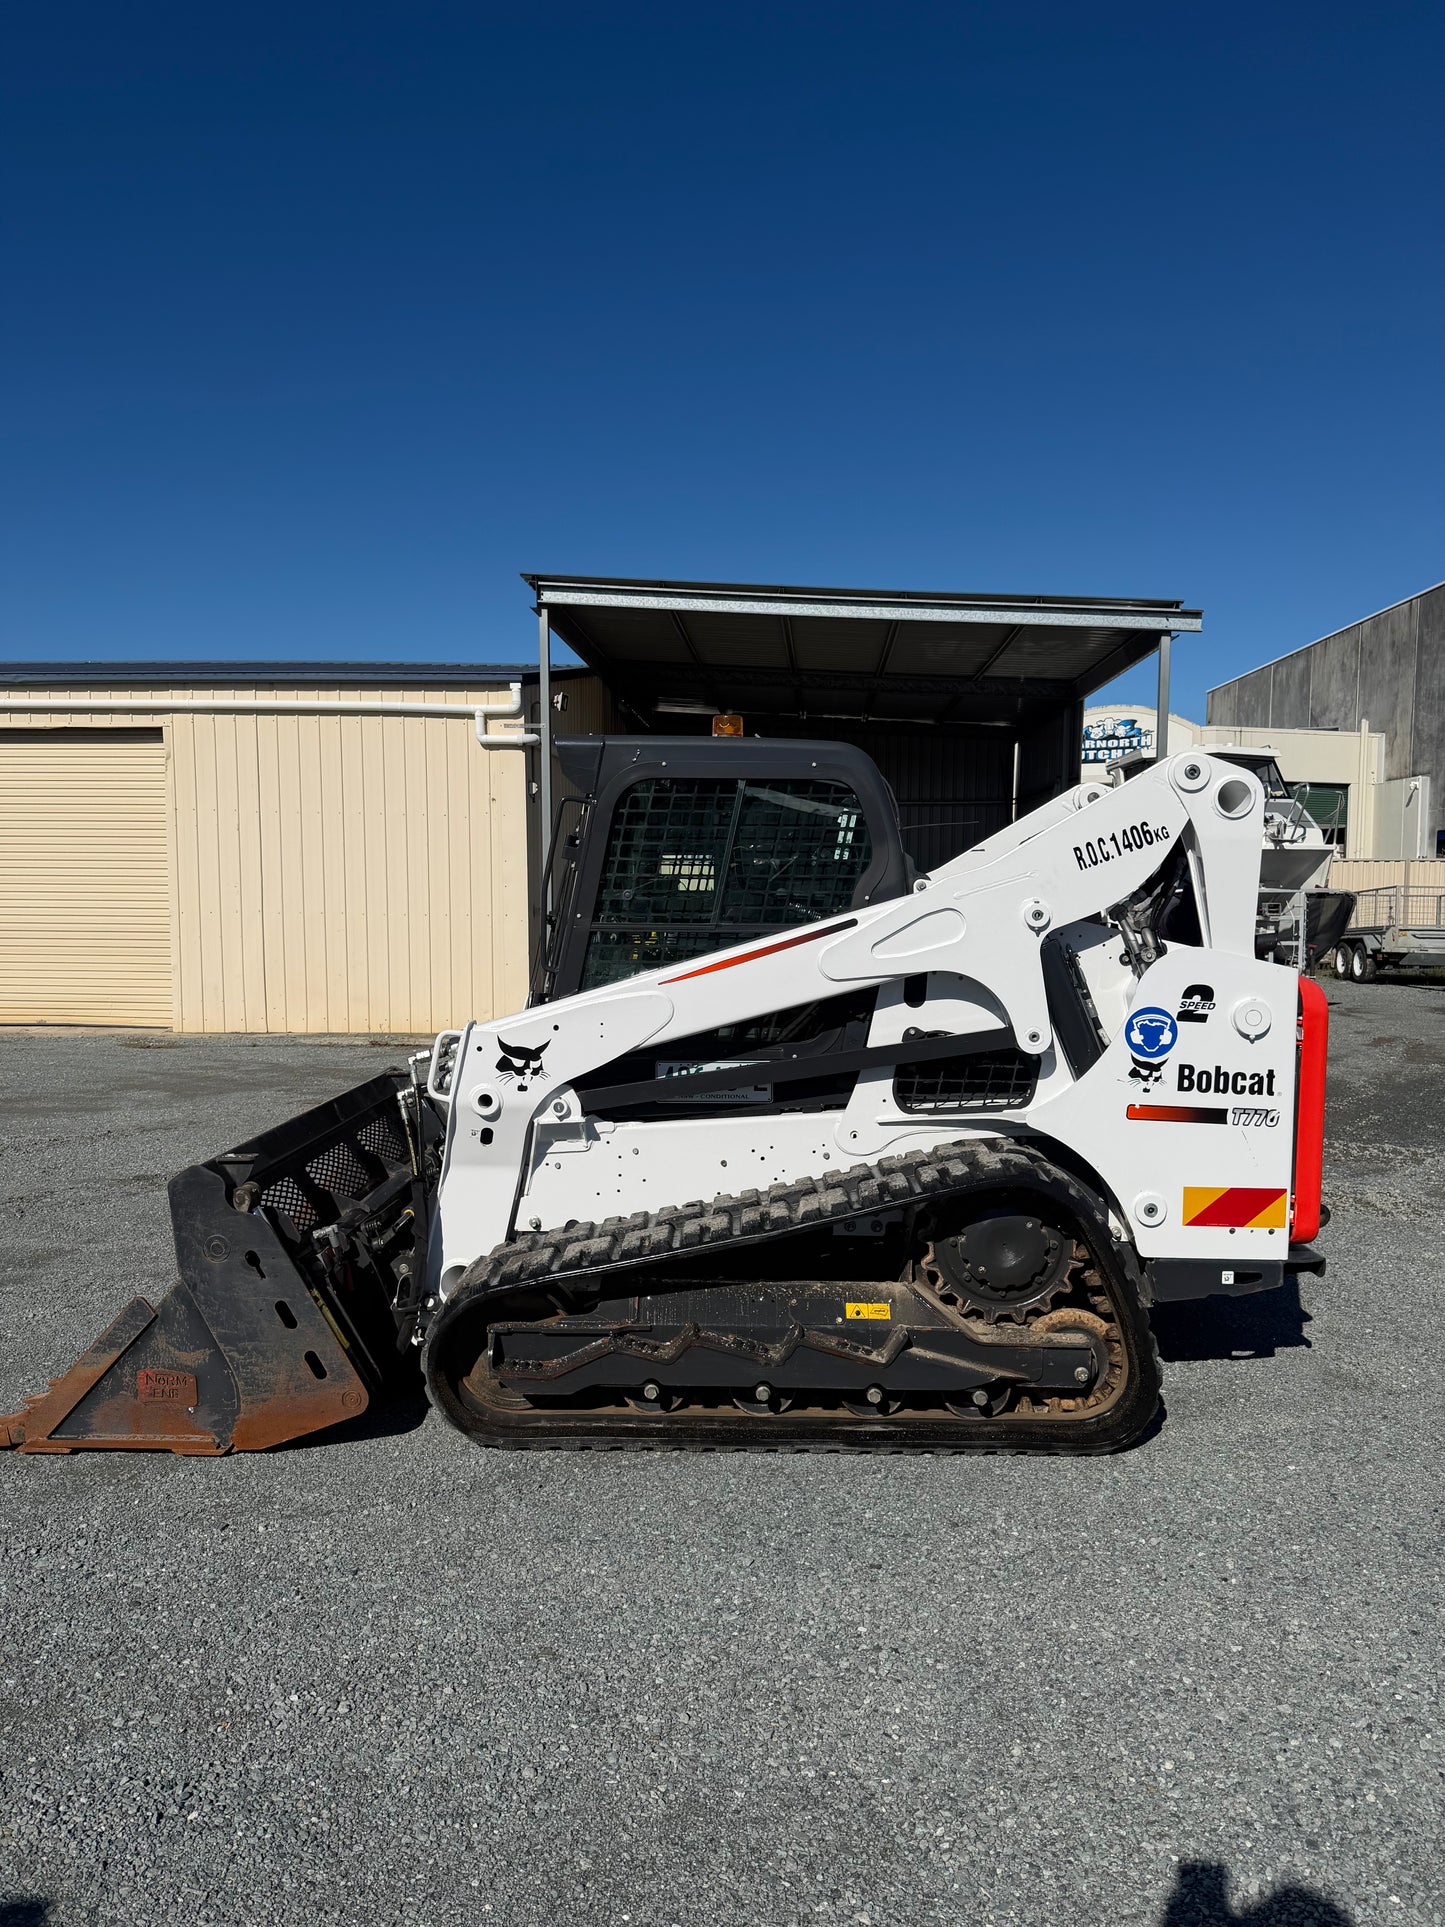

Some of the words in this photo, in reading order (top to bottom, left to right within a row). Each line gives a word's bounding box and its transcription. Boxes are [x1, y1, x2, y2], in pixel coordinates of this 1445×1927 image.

[1082, 734, 1152, 749] RNORTH
[1176, 984, 1215, 1023] 2
[1179, 1000, 1216, 1011] SPEED
[1177, 1063, 1275, 1096] Bobcat
[1232, 1107, 1281, 1128] T770
